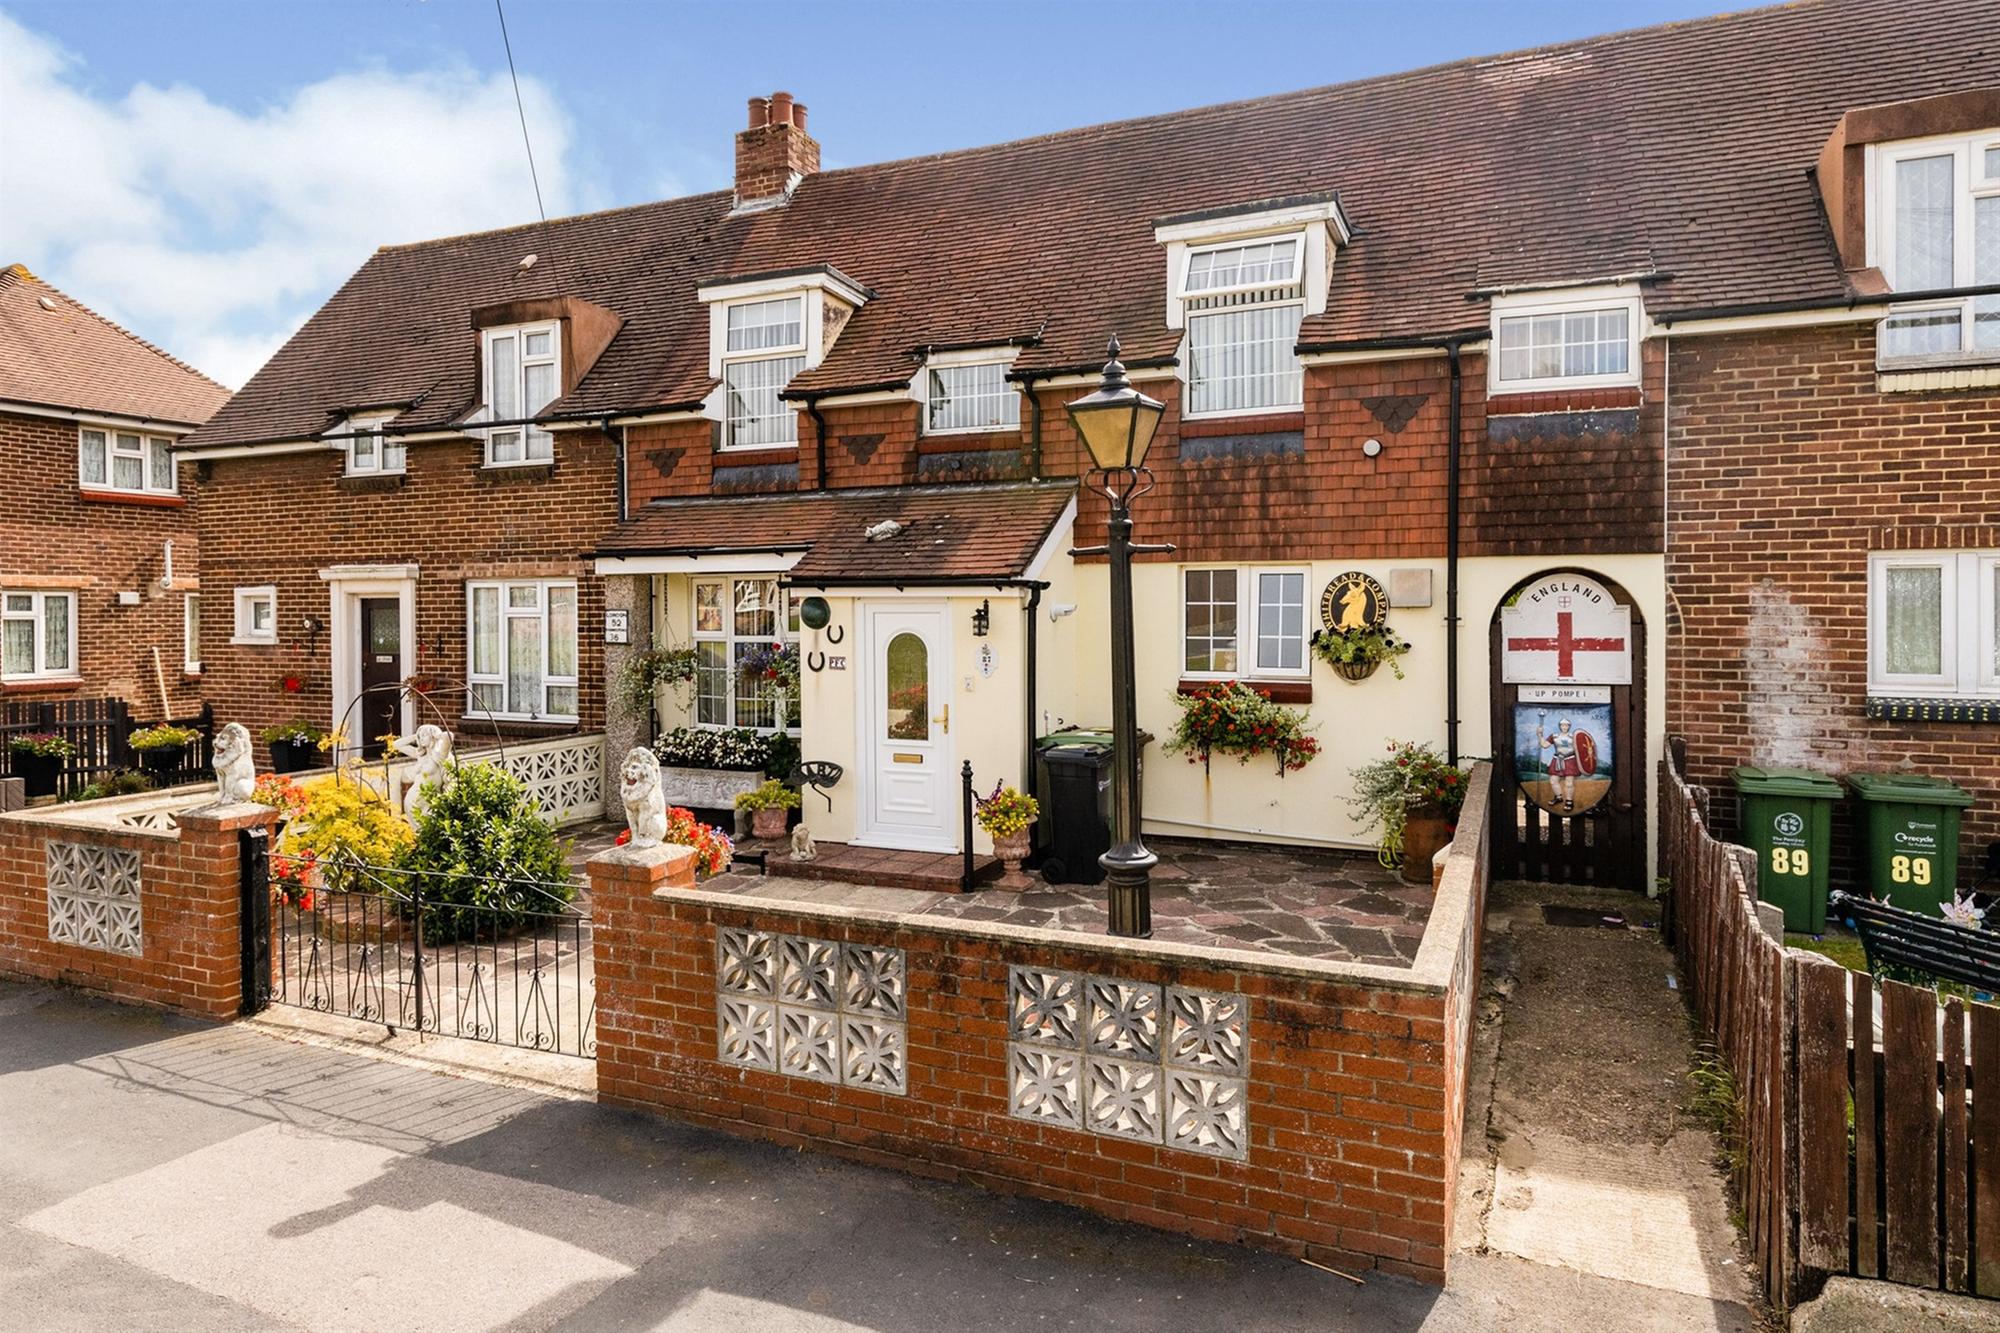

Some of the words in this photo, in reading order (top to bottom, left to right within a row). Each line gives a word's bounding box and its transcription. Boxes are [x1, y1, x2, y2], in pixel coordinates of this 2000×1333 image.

[1321, 572, 1357, 630] WHITBREAD
[1531, 582, 1602, 604] ENGLAND
[611, 619, 622, 627] 52
[1552, 690, 1586, 698] POMPEI
[1907, 835, 1934, 843] recycle
[1772, 847, 1809, 876] 89
[1891, 855, 1931, 885] 89
